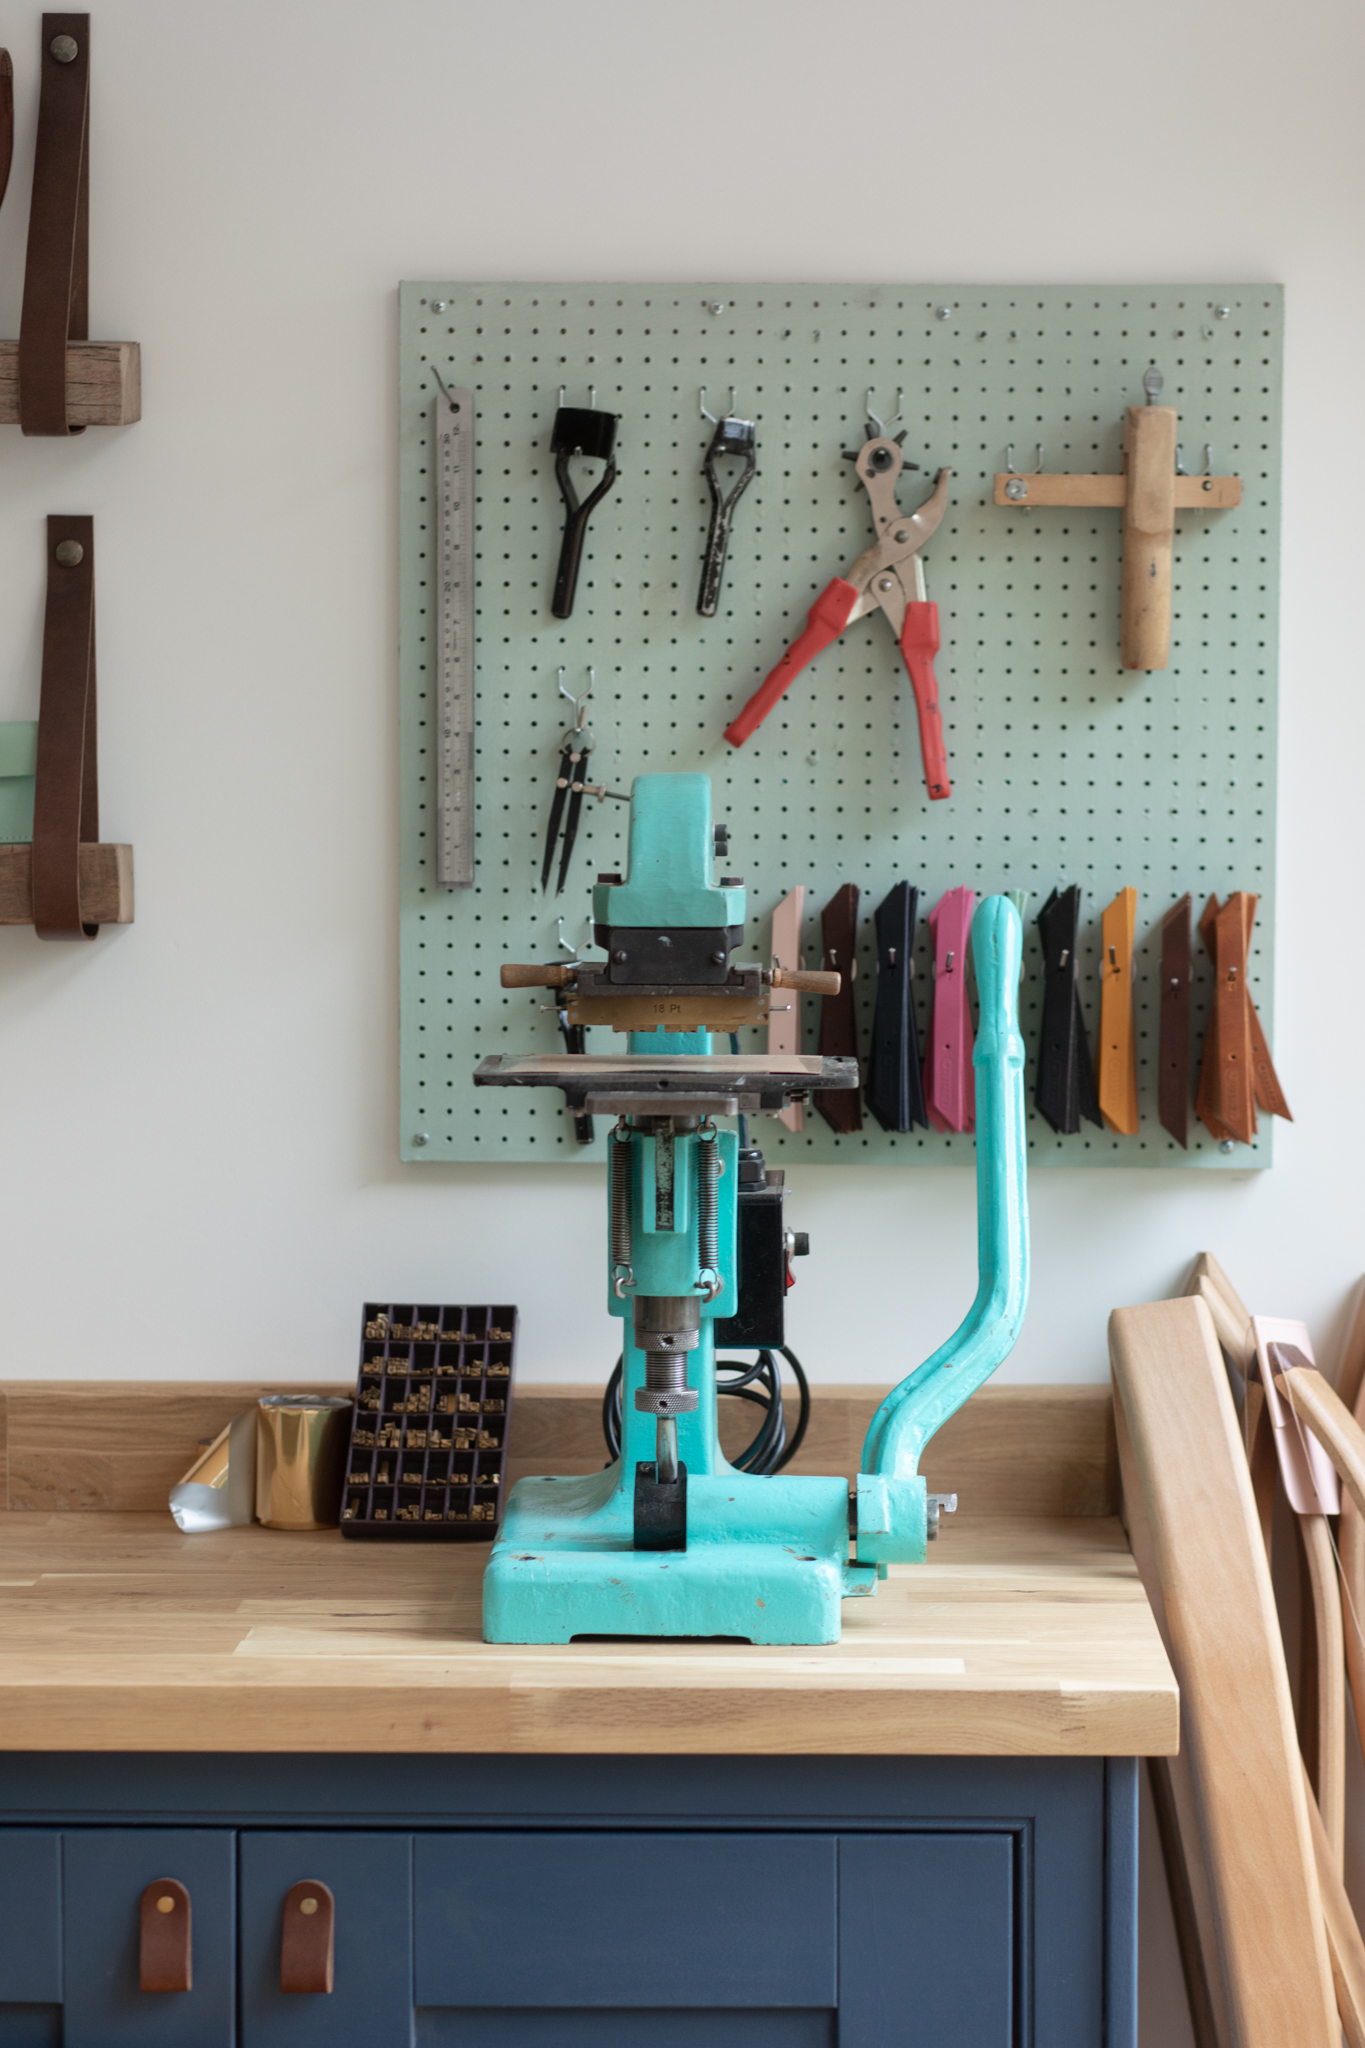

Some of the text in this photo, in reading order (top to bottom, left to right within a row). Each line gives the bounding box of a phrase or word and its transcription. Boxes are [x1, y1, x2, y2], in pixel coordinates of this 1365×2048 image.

[453, 501, 460, 511] 10
[444, 581, 451, 592] 20
[445, 729, 451, 738] 10
[653, 1004, 682, 1013] 18 Pt
